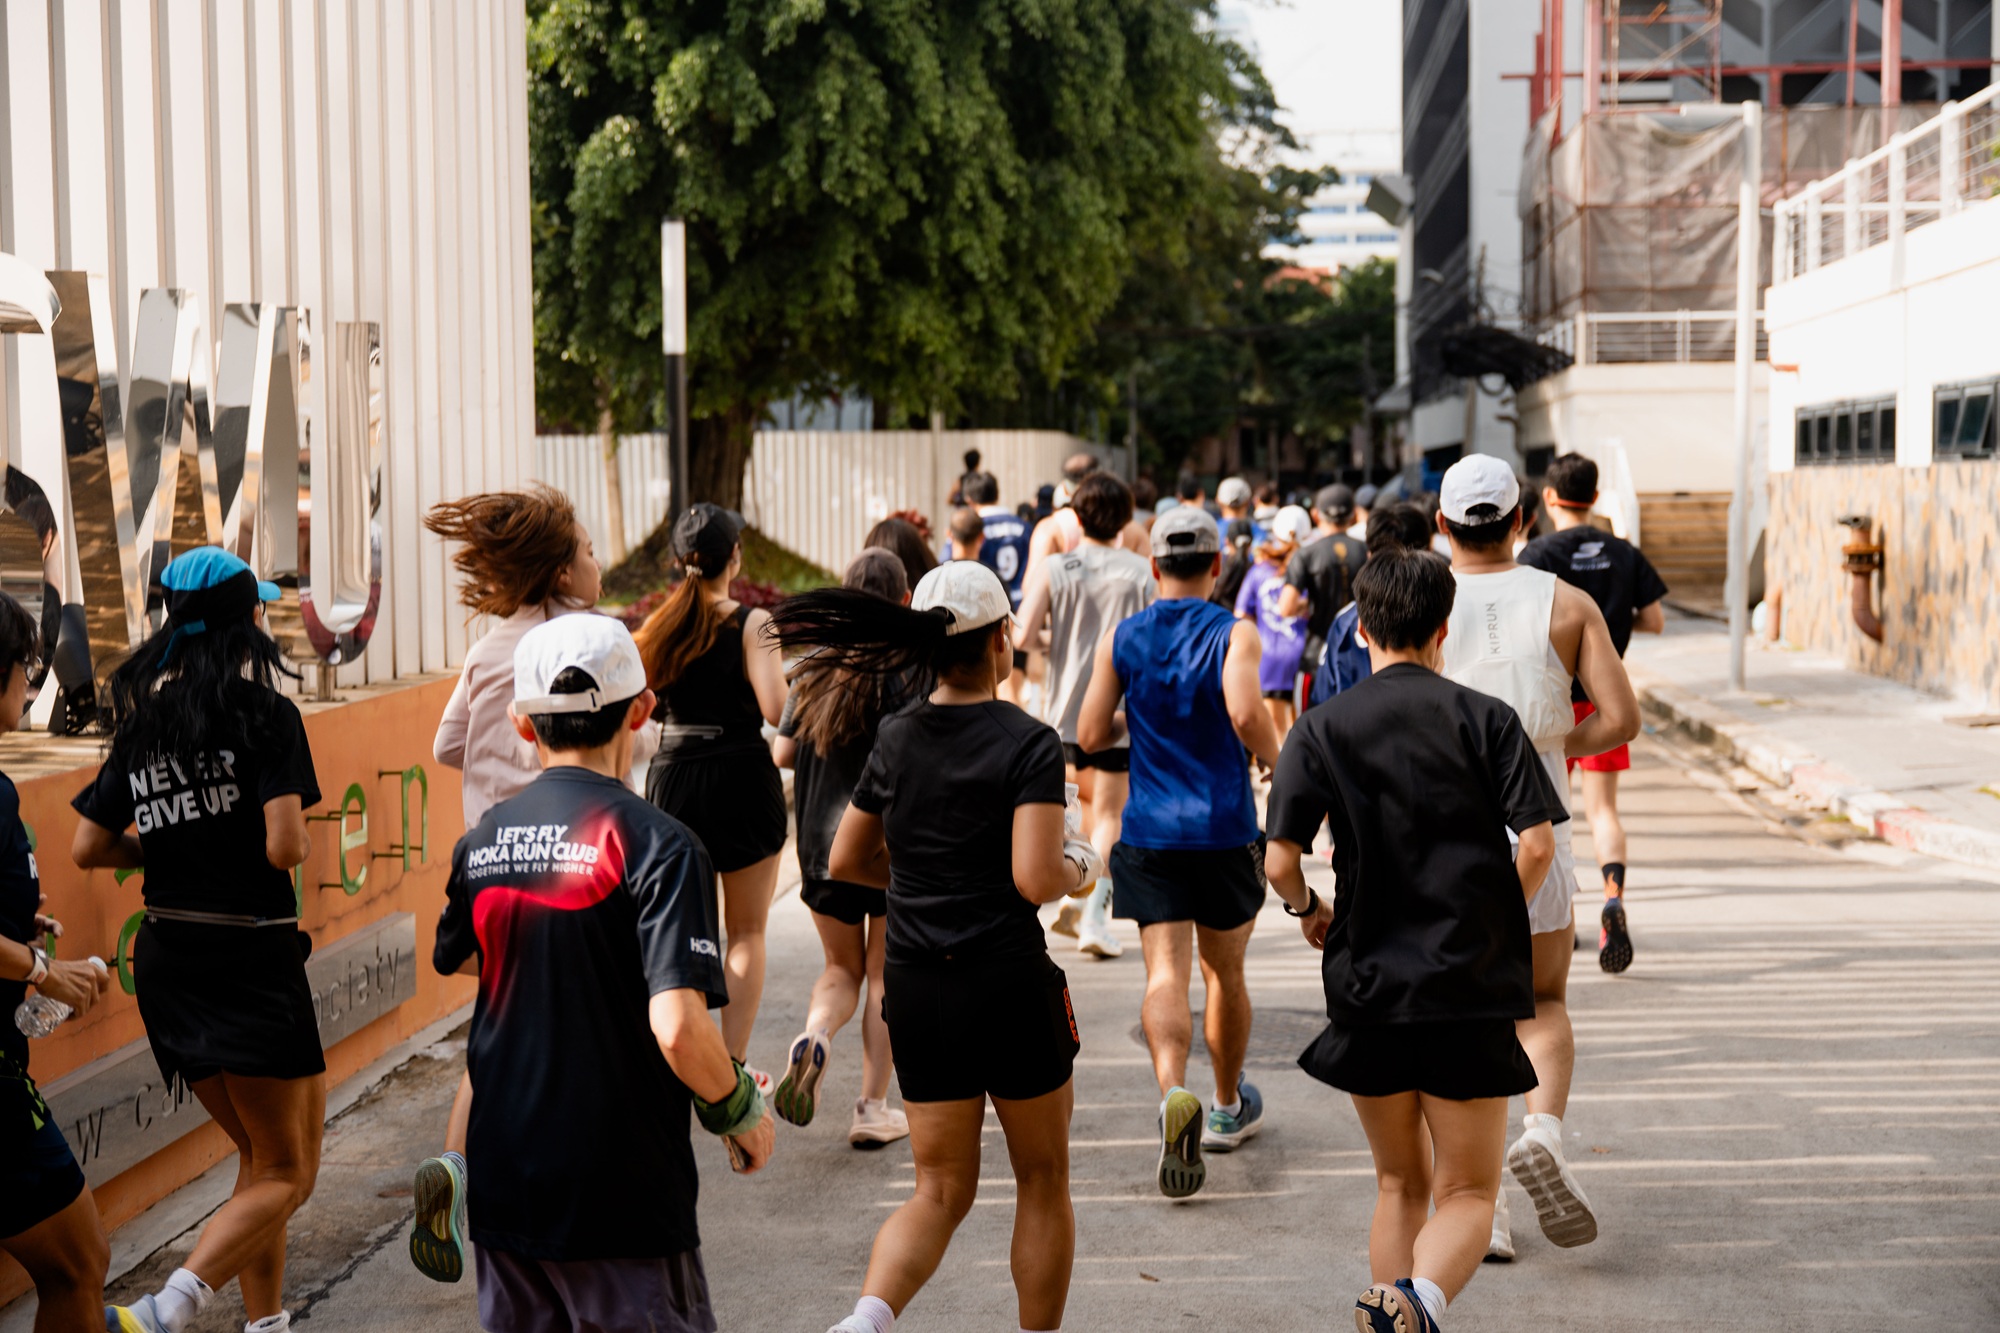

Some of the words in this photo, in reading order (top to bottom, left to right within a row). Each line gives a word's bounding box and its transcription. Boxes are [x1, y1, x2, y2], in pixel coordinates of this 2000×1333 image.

[1485, 602, 1501, 655] KIPRUN
[134, 790, 201, 834] GIVE
[202, 783, 241, 816] UP
[496, 826, 536, 845] LET'S
[537, 824, 568, 843] FLY
[468, 844, 510, 869] HOKA
[512, 842, 551, 862] RUN
[552, 842, 598, 864] CLUB
[467, 864, 510, 880] TOGETHER
[513, 863, 529, 873] WE
[532, 862, 549, 873] FLY
[552, 862, 594, 876] HIGHER
